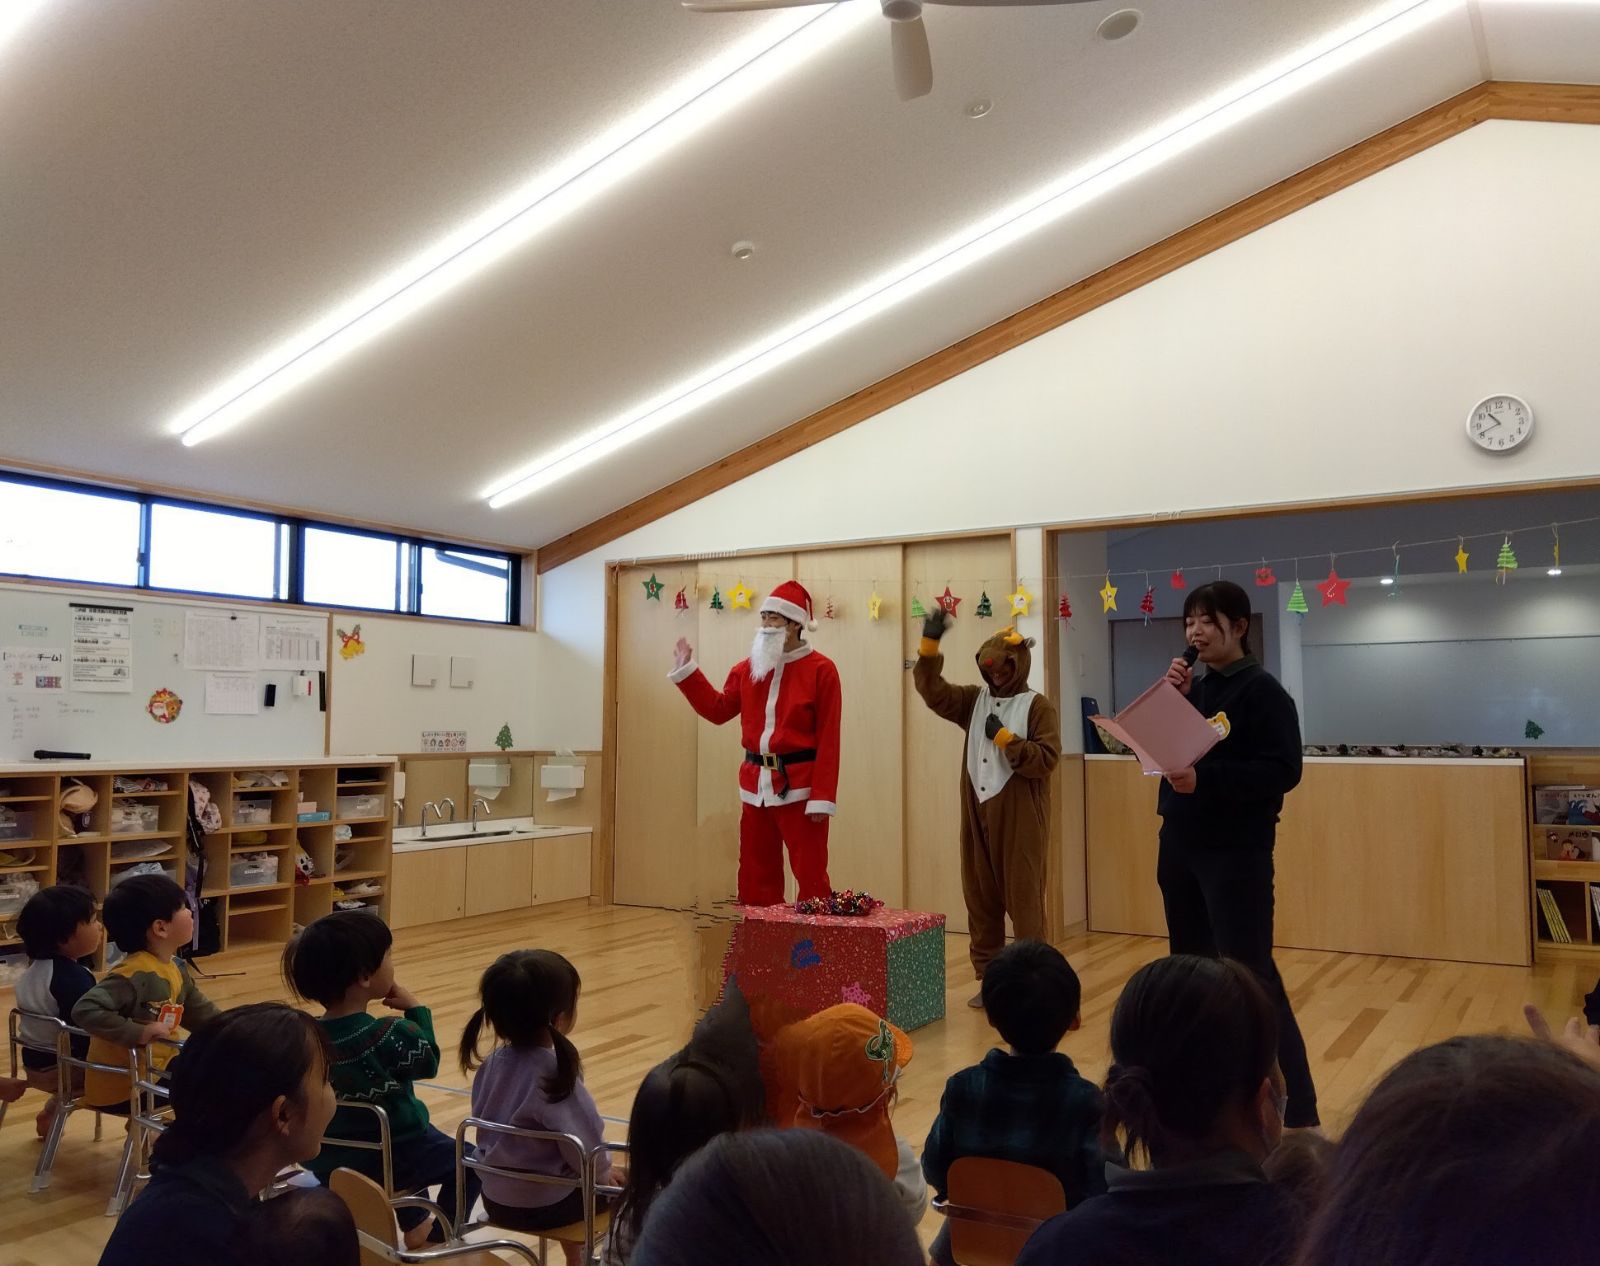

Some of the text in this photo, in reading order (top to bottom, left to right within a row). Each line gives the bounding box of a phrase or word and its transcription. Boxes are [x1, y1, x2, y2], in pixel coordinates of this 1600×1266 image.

[1494, 400, 1504, 409] 12
[1514, 408, 1521, 416] 2
[1518, 417, 1524, 425] 3
[1516, 427, 1522, 435] 4
[1509, 434, 1515, 442] 5
[1498, 438, 1504, 448] 6
